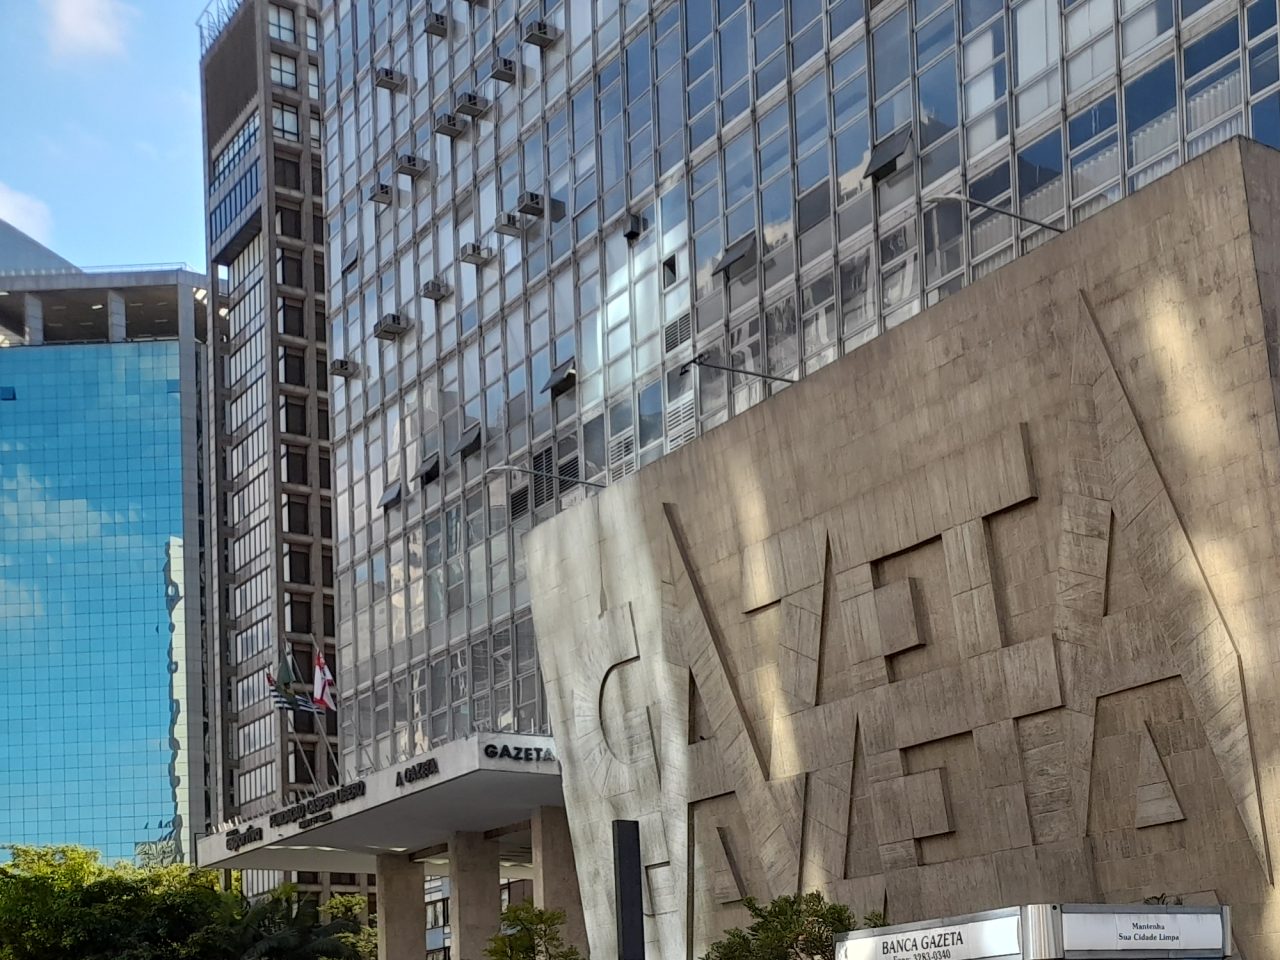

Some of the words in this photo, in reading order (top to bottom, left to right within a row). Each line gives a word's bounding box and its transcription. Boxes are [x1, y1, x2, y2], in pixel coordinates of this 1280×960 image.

[484, 744, 556, 762] GAZETA
[405, 757, 440, 783] GAZETA
[1132, 922, 1165, 930] Mantenha
[882, 938, 918, 955] BANCA
[921, 931, 964, 950] GAZETA
[1118, 933, 1131, 941] Sua
[1133, 933, 1157, 941] Cidade
[1159, 933, 1179, 942] Limpa
